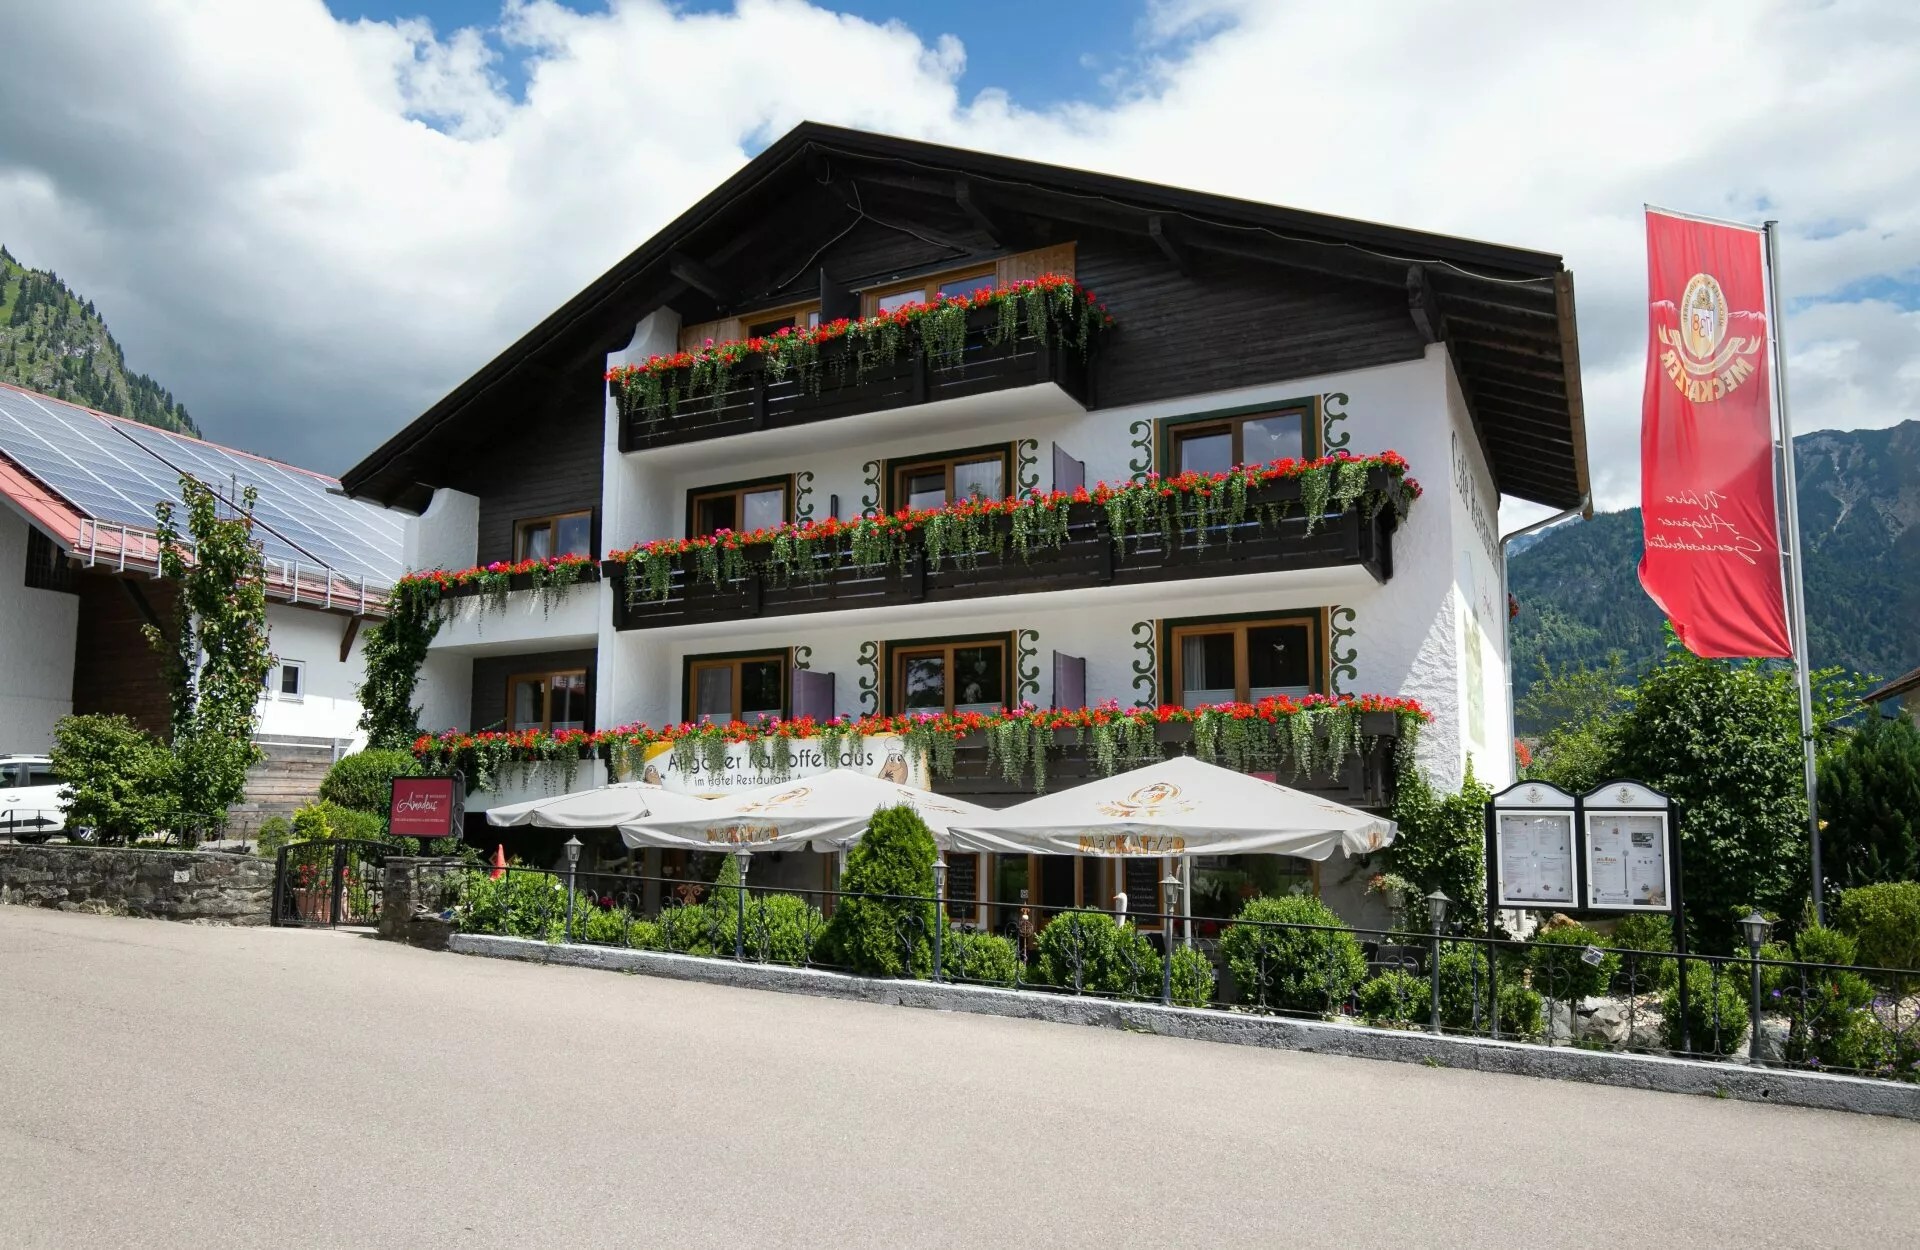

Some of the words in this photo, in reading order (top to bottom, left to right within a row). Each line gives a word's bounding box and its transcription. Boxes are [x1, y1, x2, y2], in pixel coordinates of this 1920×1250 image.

[668, 752, 741, 774] Alger
[749, 749, 873, 769] Kaoffelaus
[695, 776, 705, 786] im
[708, 774, 734, 786] Hotel
